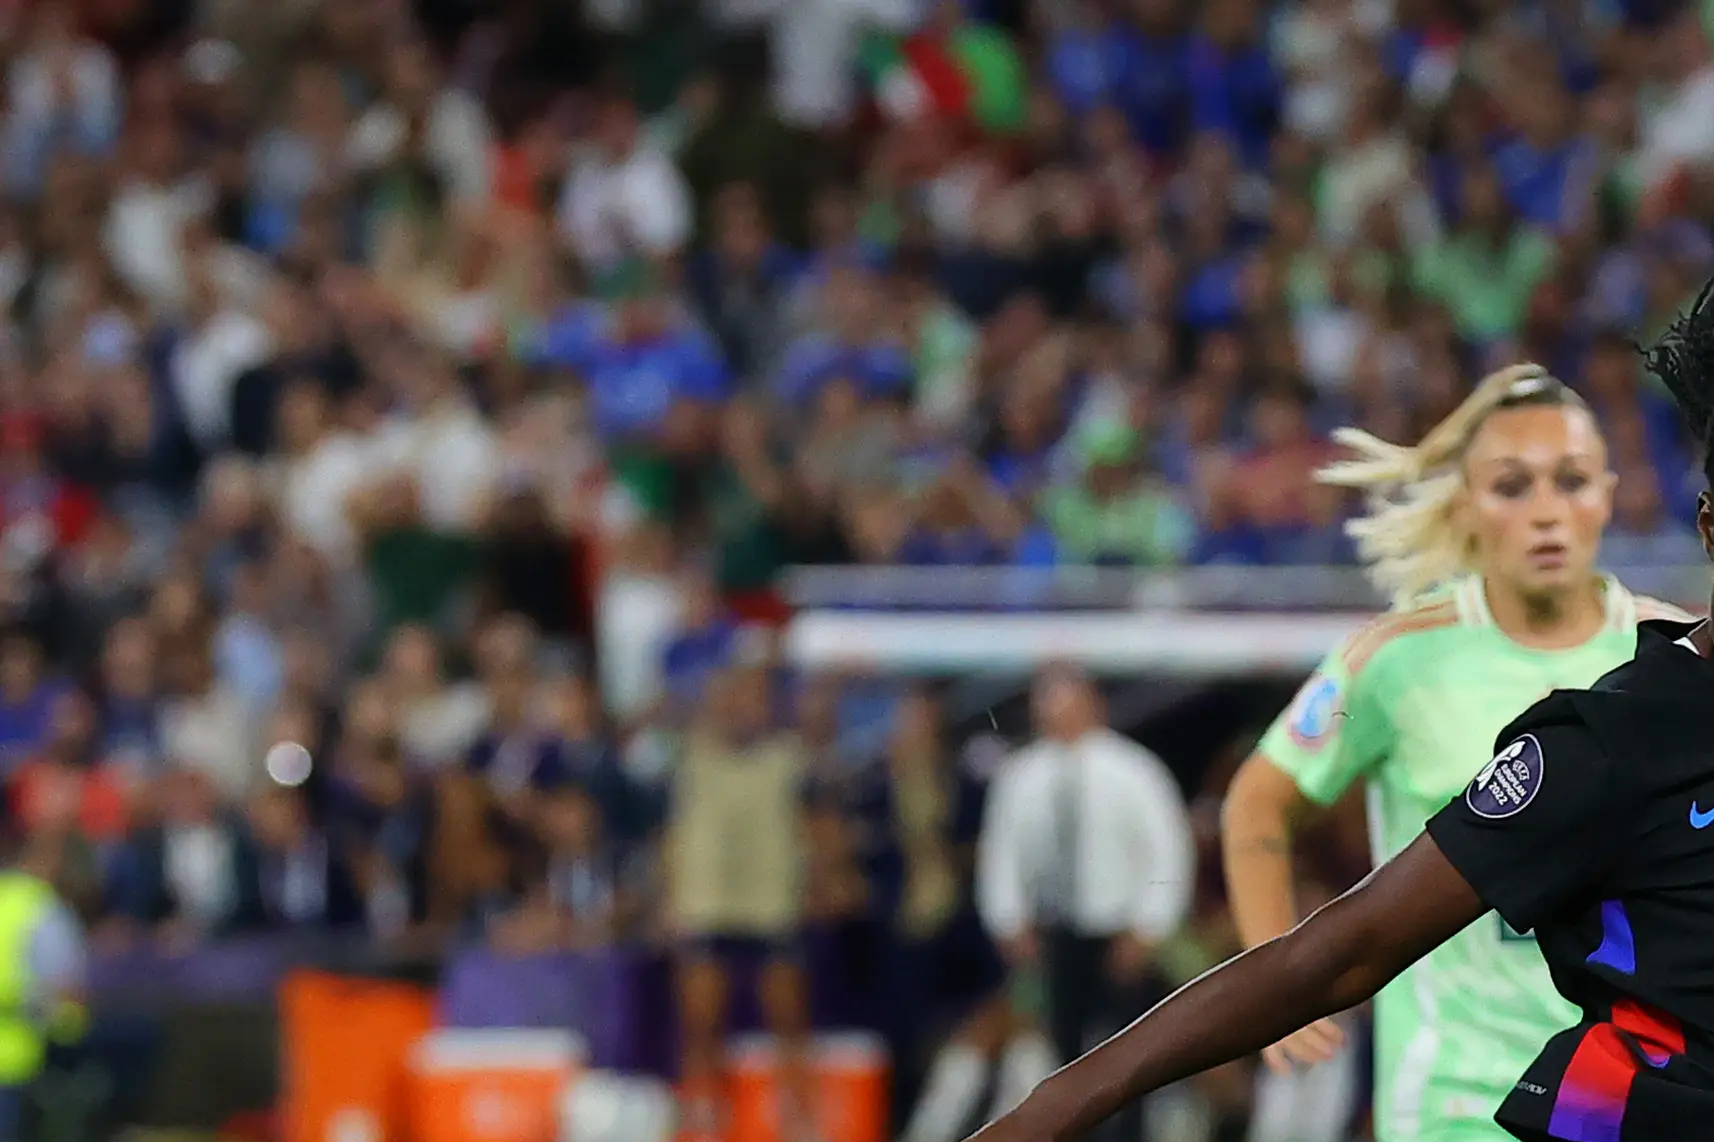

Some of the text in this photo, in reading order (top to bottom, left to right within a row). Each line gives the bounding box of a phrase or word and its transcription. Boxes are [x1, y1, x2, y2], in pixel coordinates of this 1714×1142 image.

[1501, 763, 1527, 797] EUROPEAN
[1512, 760, 1530, 781] UEFA
[1488, 781, 1508, 806] 2022
[1494, 768, 1522, 805] CHAMPIONS
